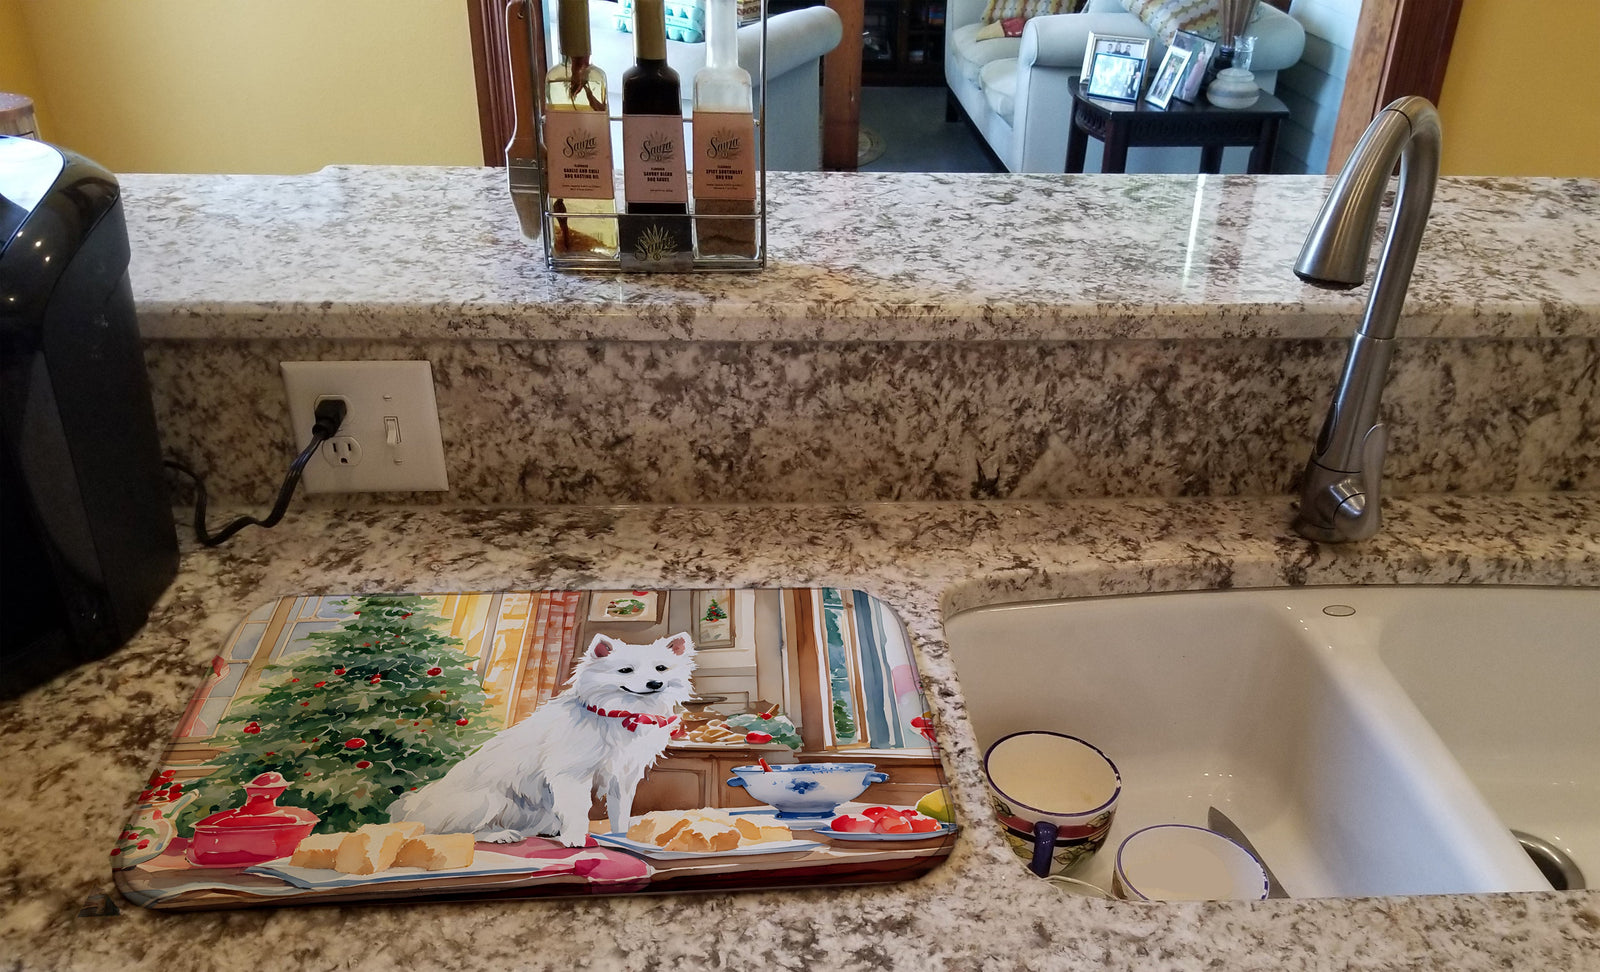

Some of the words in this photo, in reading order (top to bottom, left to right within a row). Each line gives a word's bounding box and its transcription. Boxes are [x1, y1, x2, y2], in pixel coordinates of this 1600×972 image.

[563, 136, 597, 158] Sauza
[640, 140, 674, 161] Sauza
[707, 136, 741, 159] Sauza
